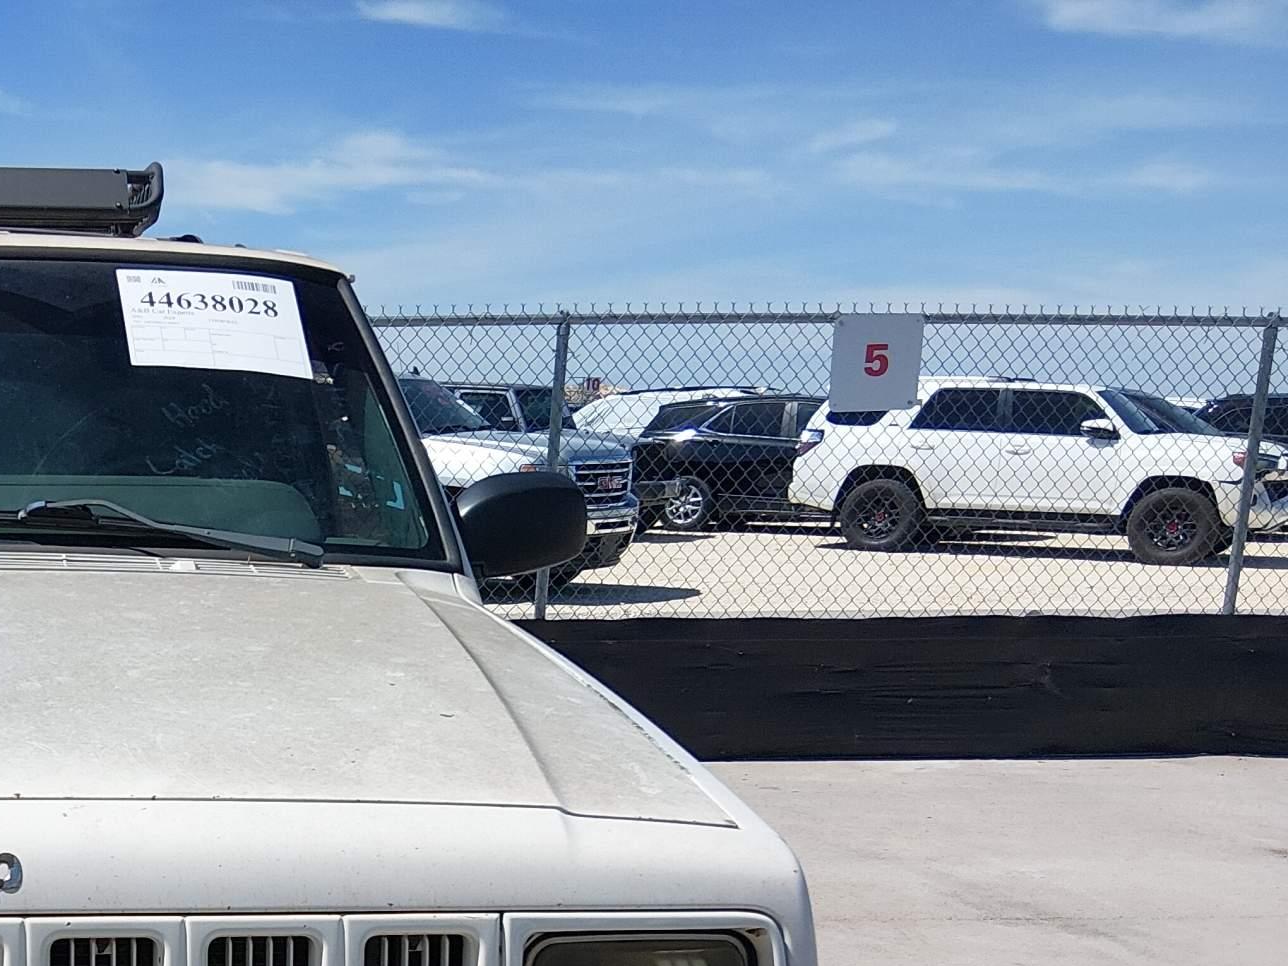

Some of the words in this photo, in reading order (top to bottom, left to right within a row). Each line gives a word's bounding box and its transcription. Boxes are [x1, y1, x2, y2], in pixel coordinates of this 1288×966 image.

[140, 291, 279, 318] 44638028
[863, 343, 889, 377] 5
[585, 377, 601, 391] 10
